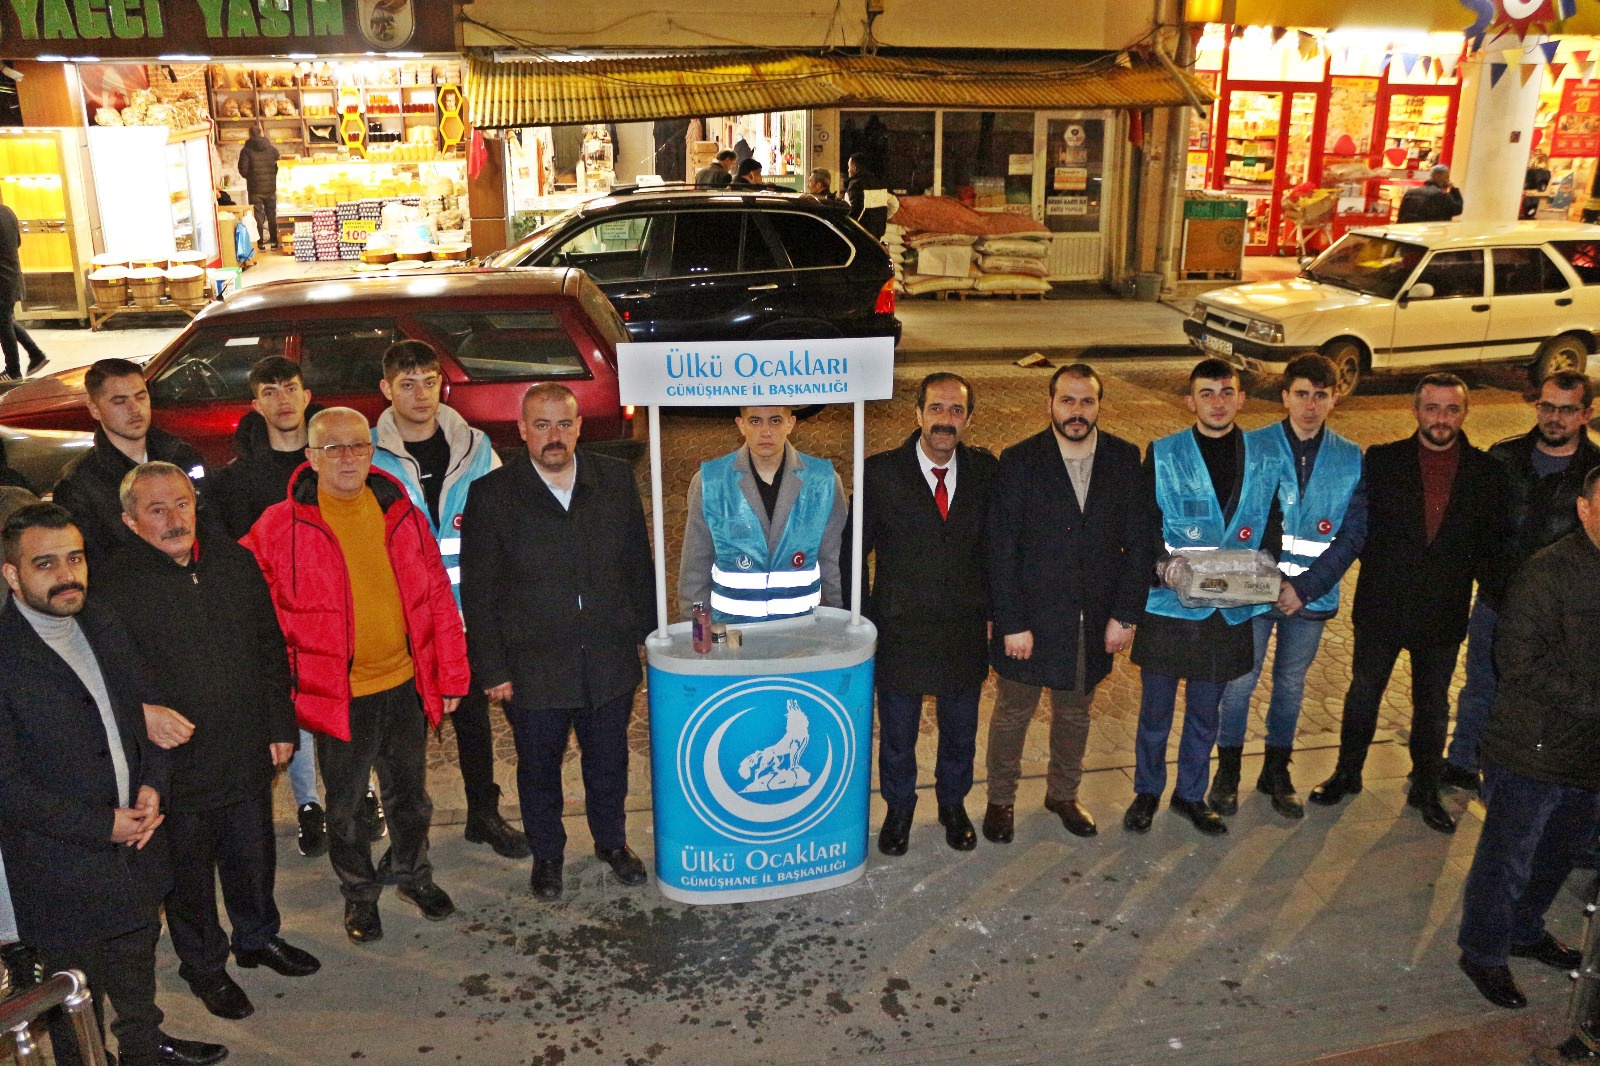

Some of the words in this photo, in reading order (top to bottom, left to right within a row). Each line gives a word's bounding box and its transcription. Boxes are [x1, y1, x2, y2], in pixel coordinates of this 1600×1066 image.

[345, 230, 367, 240] 100
[666, 383, 747, 399] GÜMÜŞHANE
[752, 382, 764, 396] İL
[769, 380, 848, 398] BAŞKANLIĞI
[1244, 581, 1271, 589] Turkish
[681, 874, 758, 889] GÜMÜŞHANE
[762, 873, 773, 883] İL
[777, 860, 846, 882] BAŞKANLIĞI
